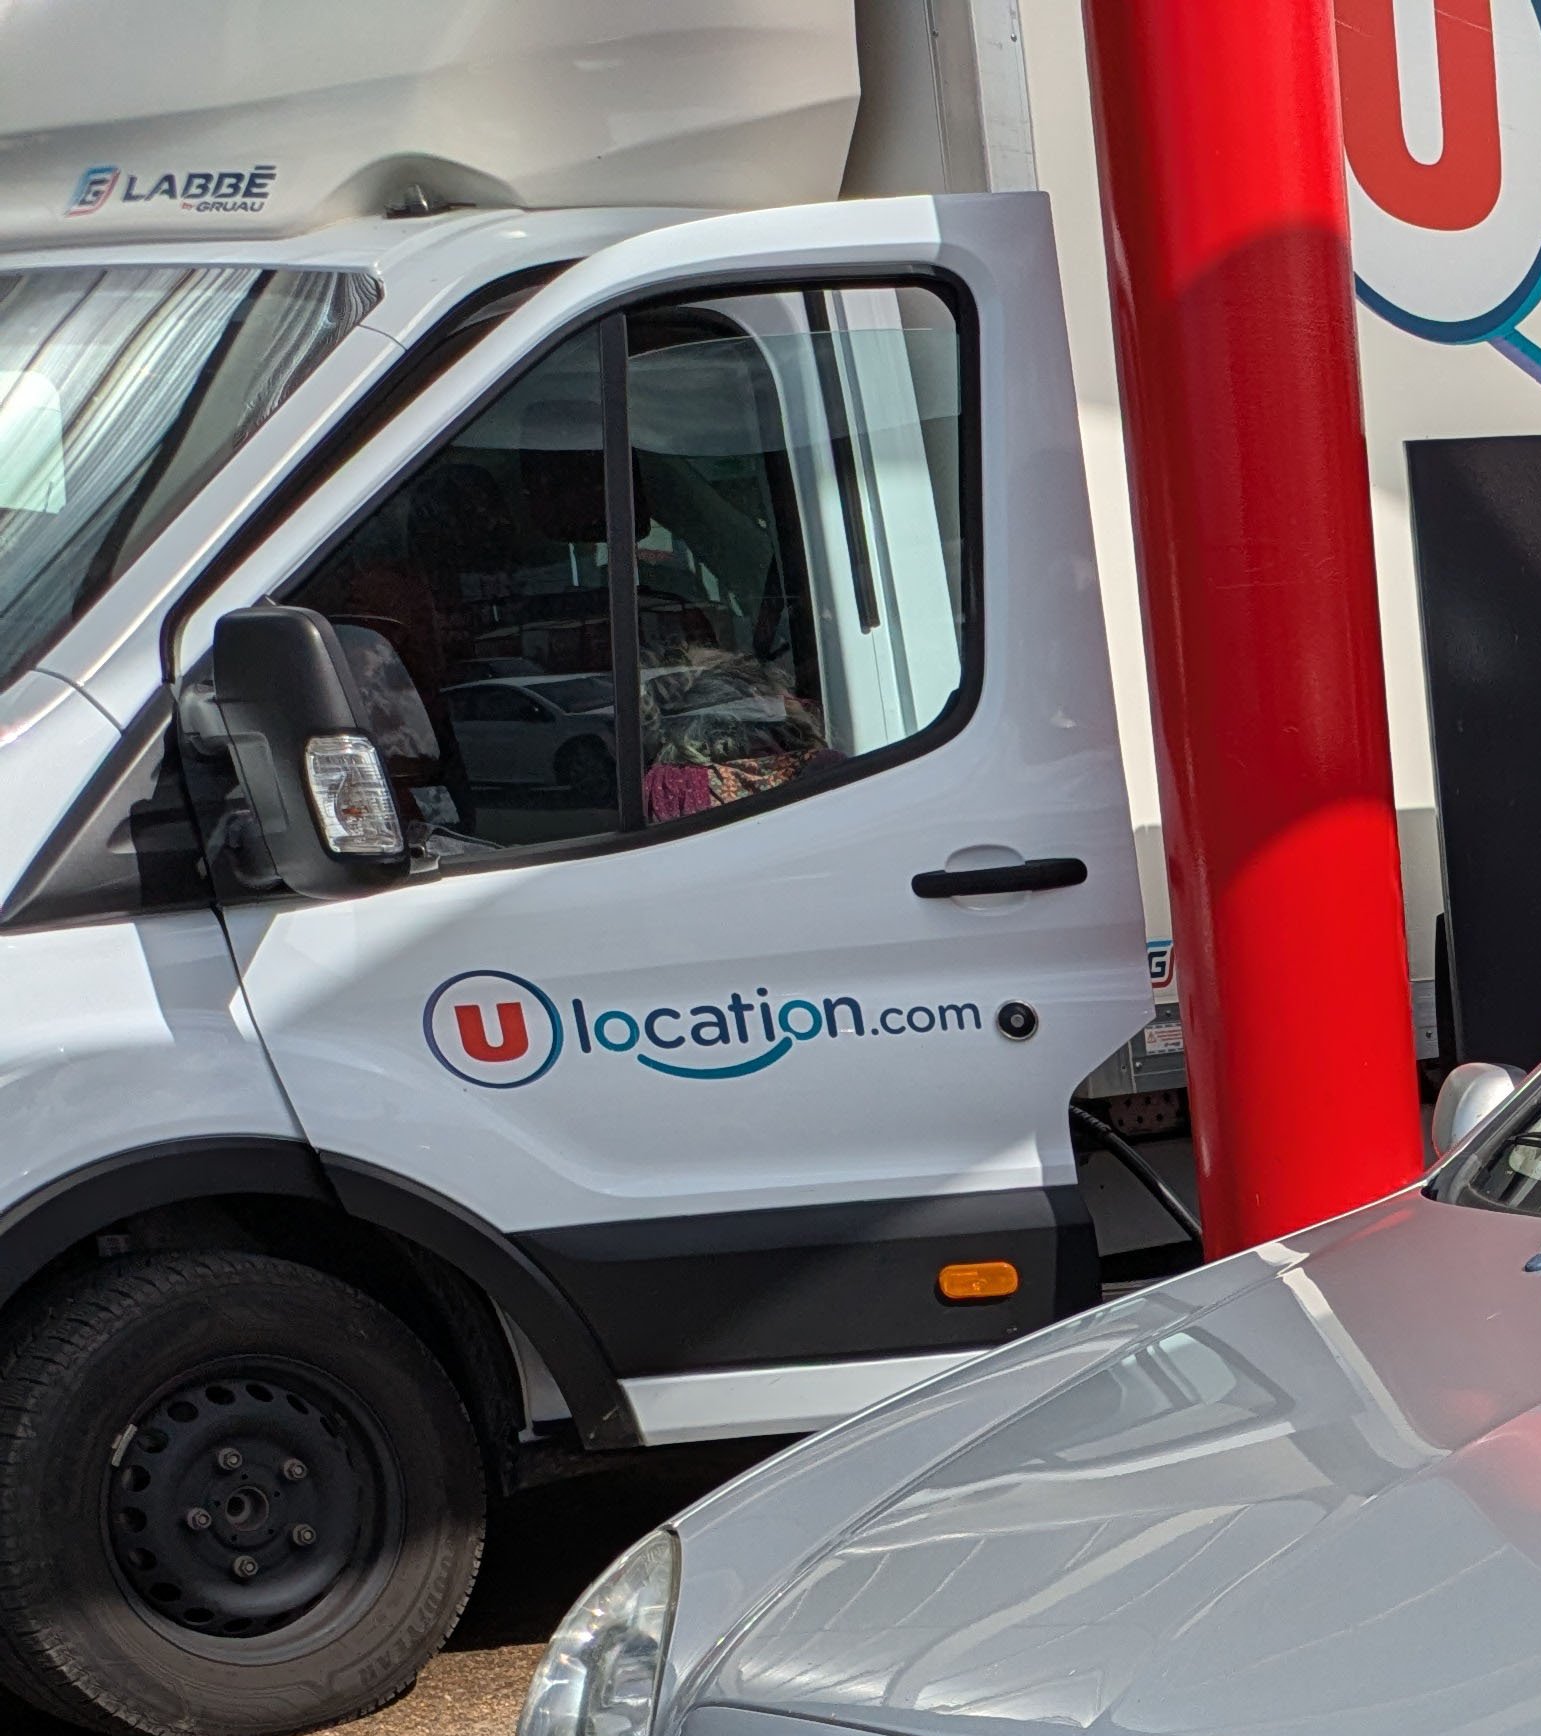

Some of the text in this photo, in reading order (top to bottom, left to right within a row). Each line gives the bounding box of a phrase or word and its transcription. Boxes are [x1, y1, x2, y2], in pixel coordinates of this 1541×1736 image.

[1337, 0, 1502, 231] U
[122, 165, 277, 203] LABBÉ
[196, 201, 265, 212] GRUAU
[453, 986, 983, 1063] U location.com
